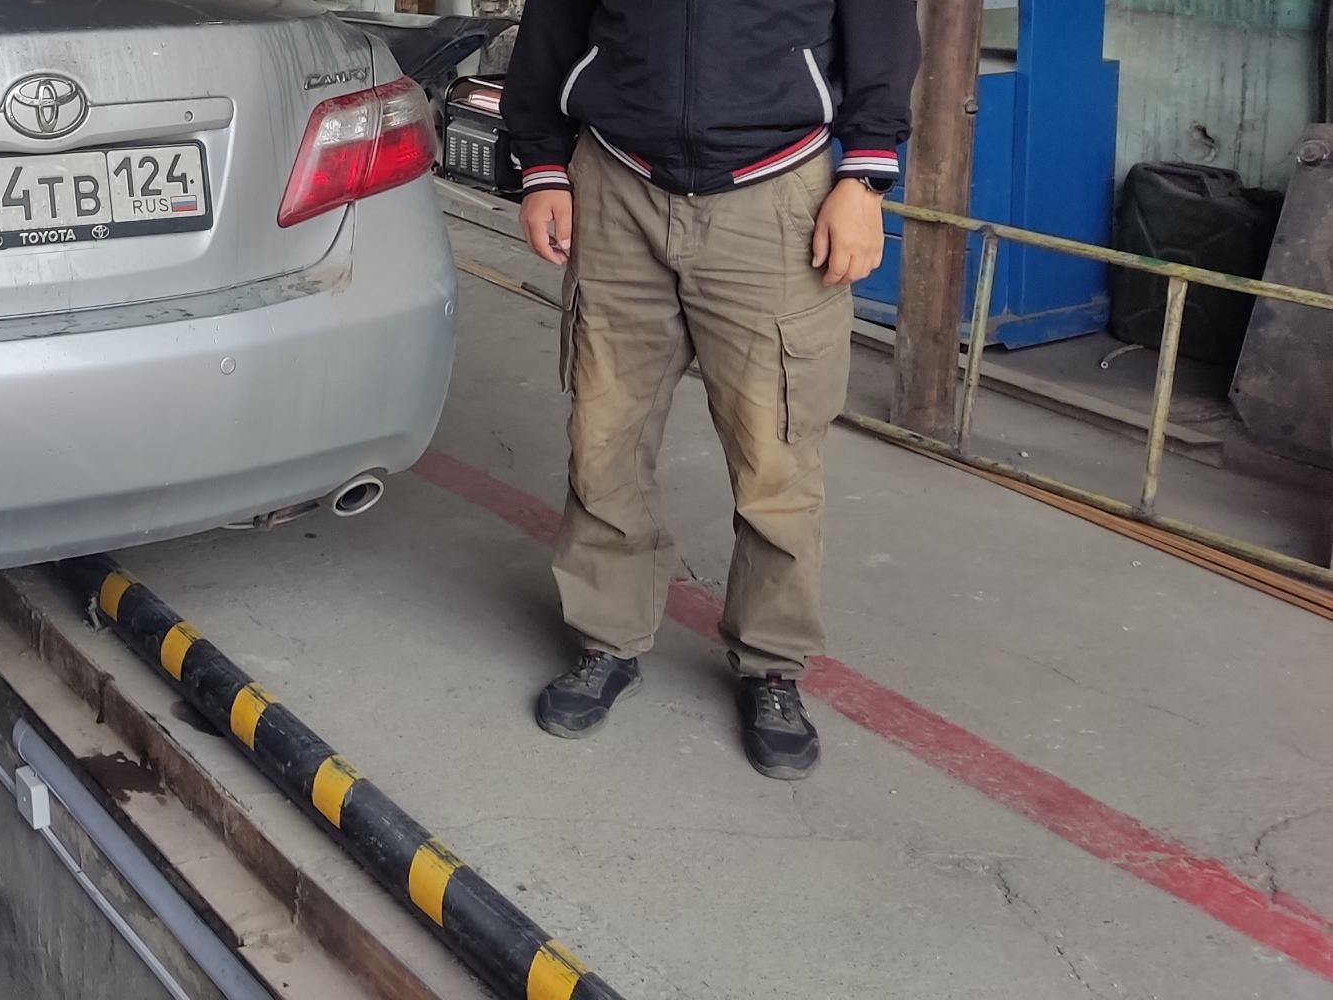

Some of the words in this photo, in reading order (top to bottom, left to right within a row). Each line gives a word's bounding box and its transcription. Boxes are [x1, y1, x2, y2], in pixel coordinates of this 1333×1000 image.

[304, 67, 370, 91] CAMRY
[113, 153, 190, 198] 124
[132, 198, 169, 215] RUS
[19, 228, 77, 245] TOYOTA
